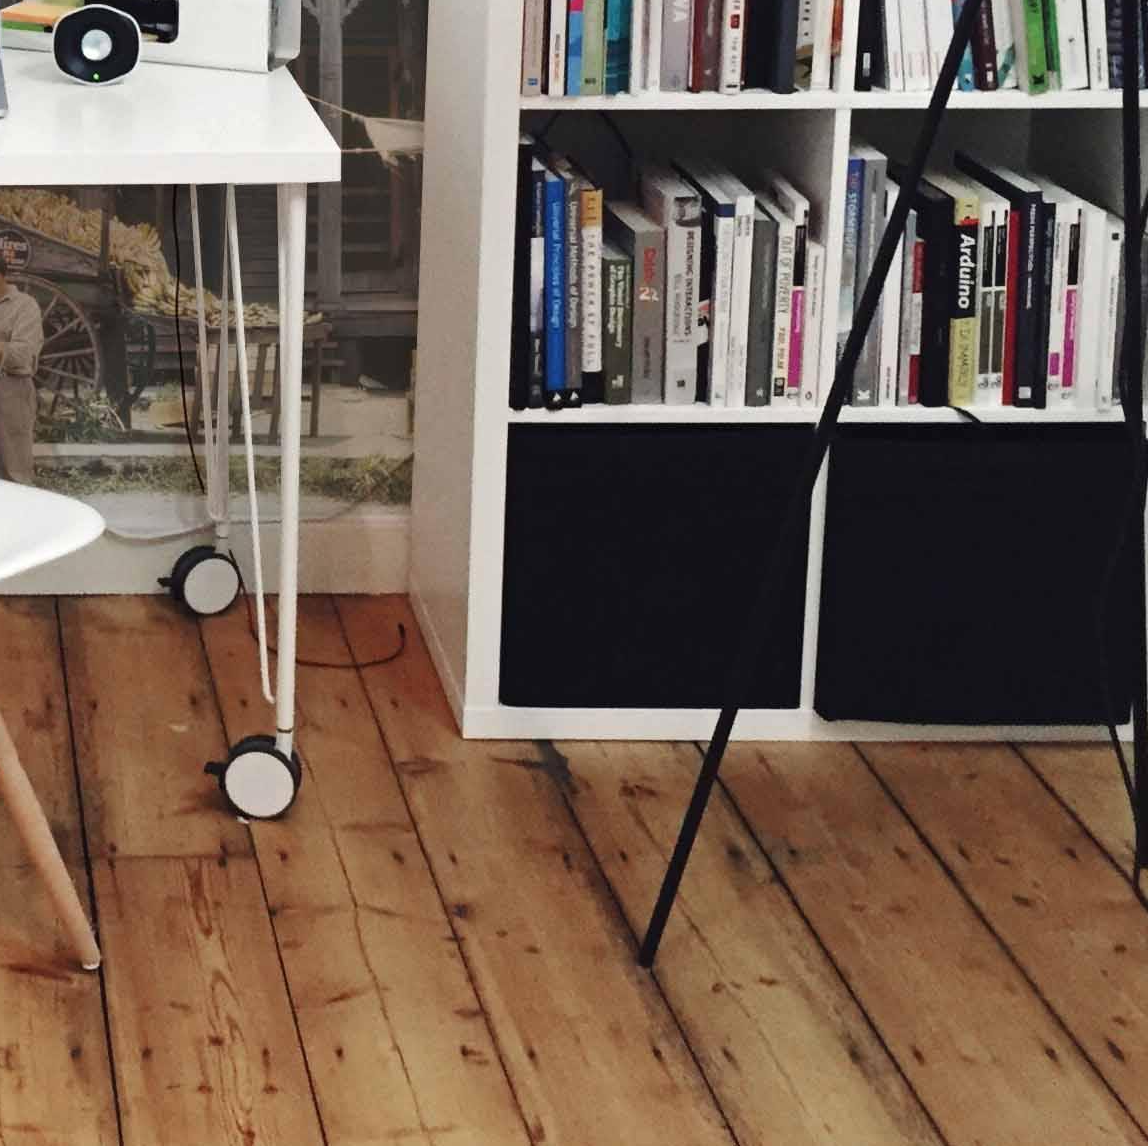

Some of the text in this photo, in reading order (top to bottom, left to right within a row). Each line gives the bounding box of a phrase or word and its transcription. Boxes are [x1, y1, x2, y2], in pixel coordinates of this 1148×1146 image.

[958, 234, 976, 309] Arduino
[551, 299, 563, 329] Design
[778, 272, 791, 314] POVERTY
